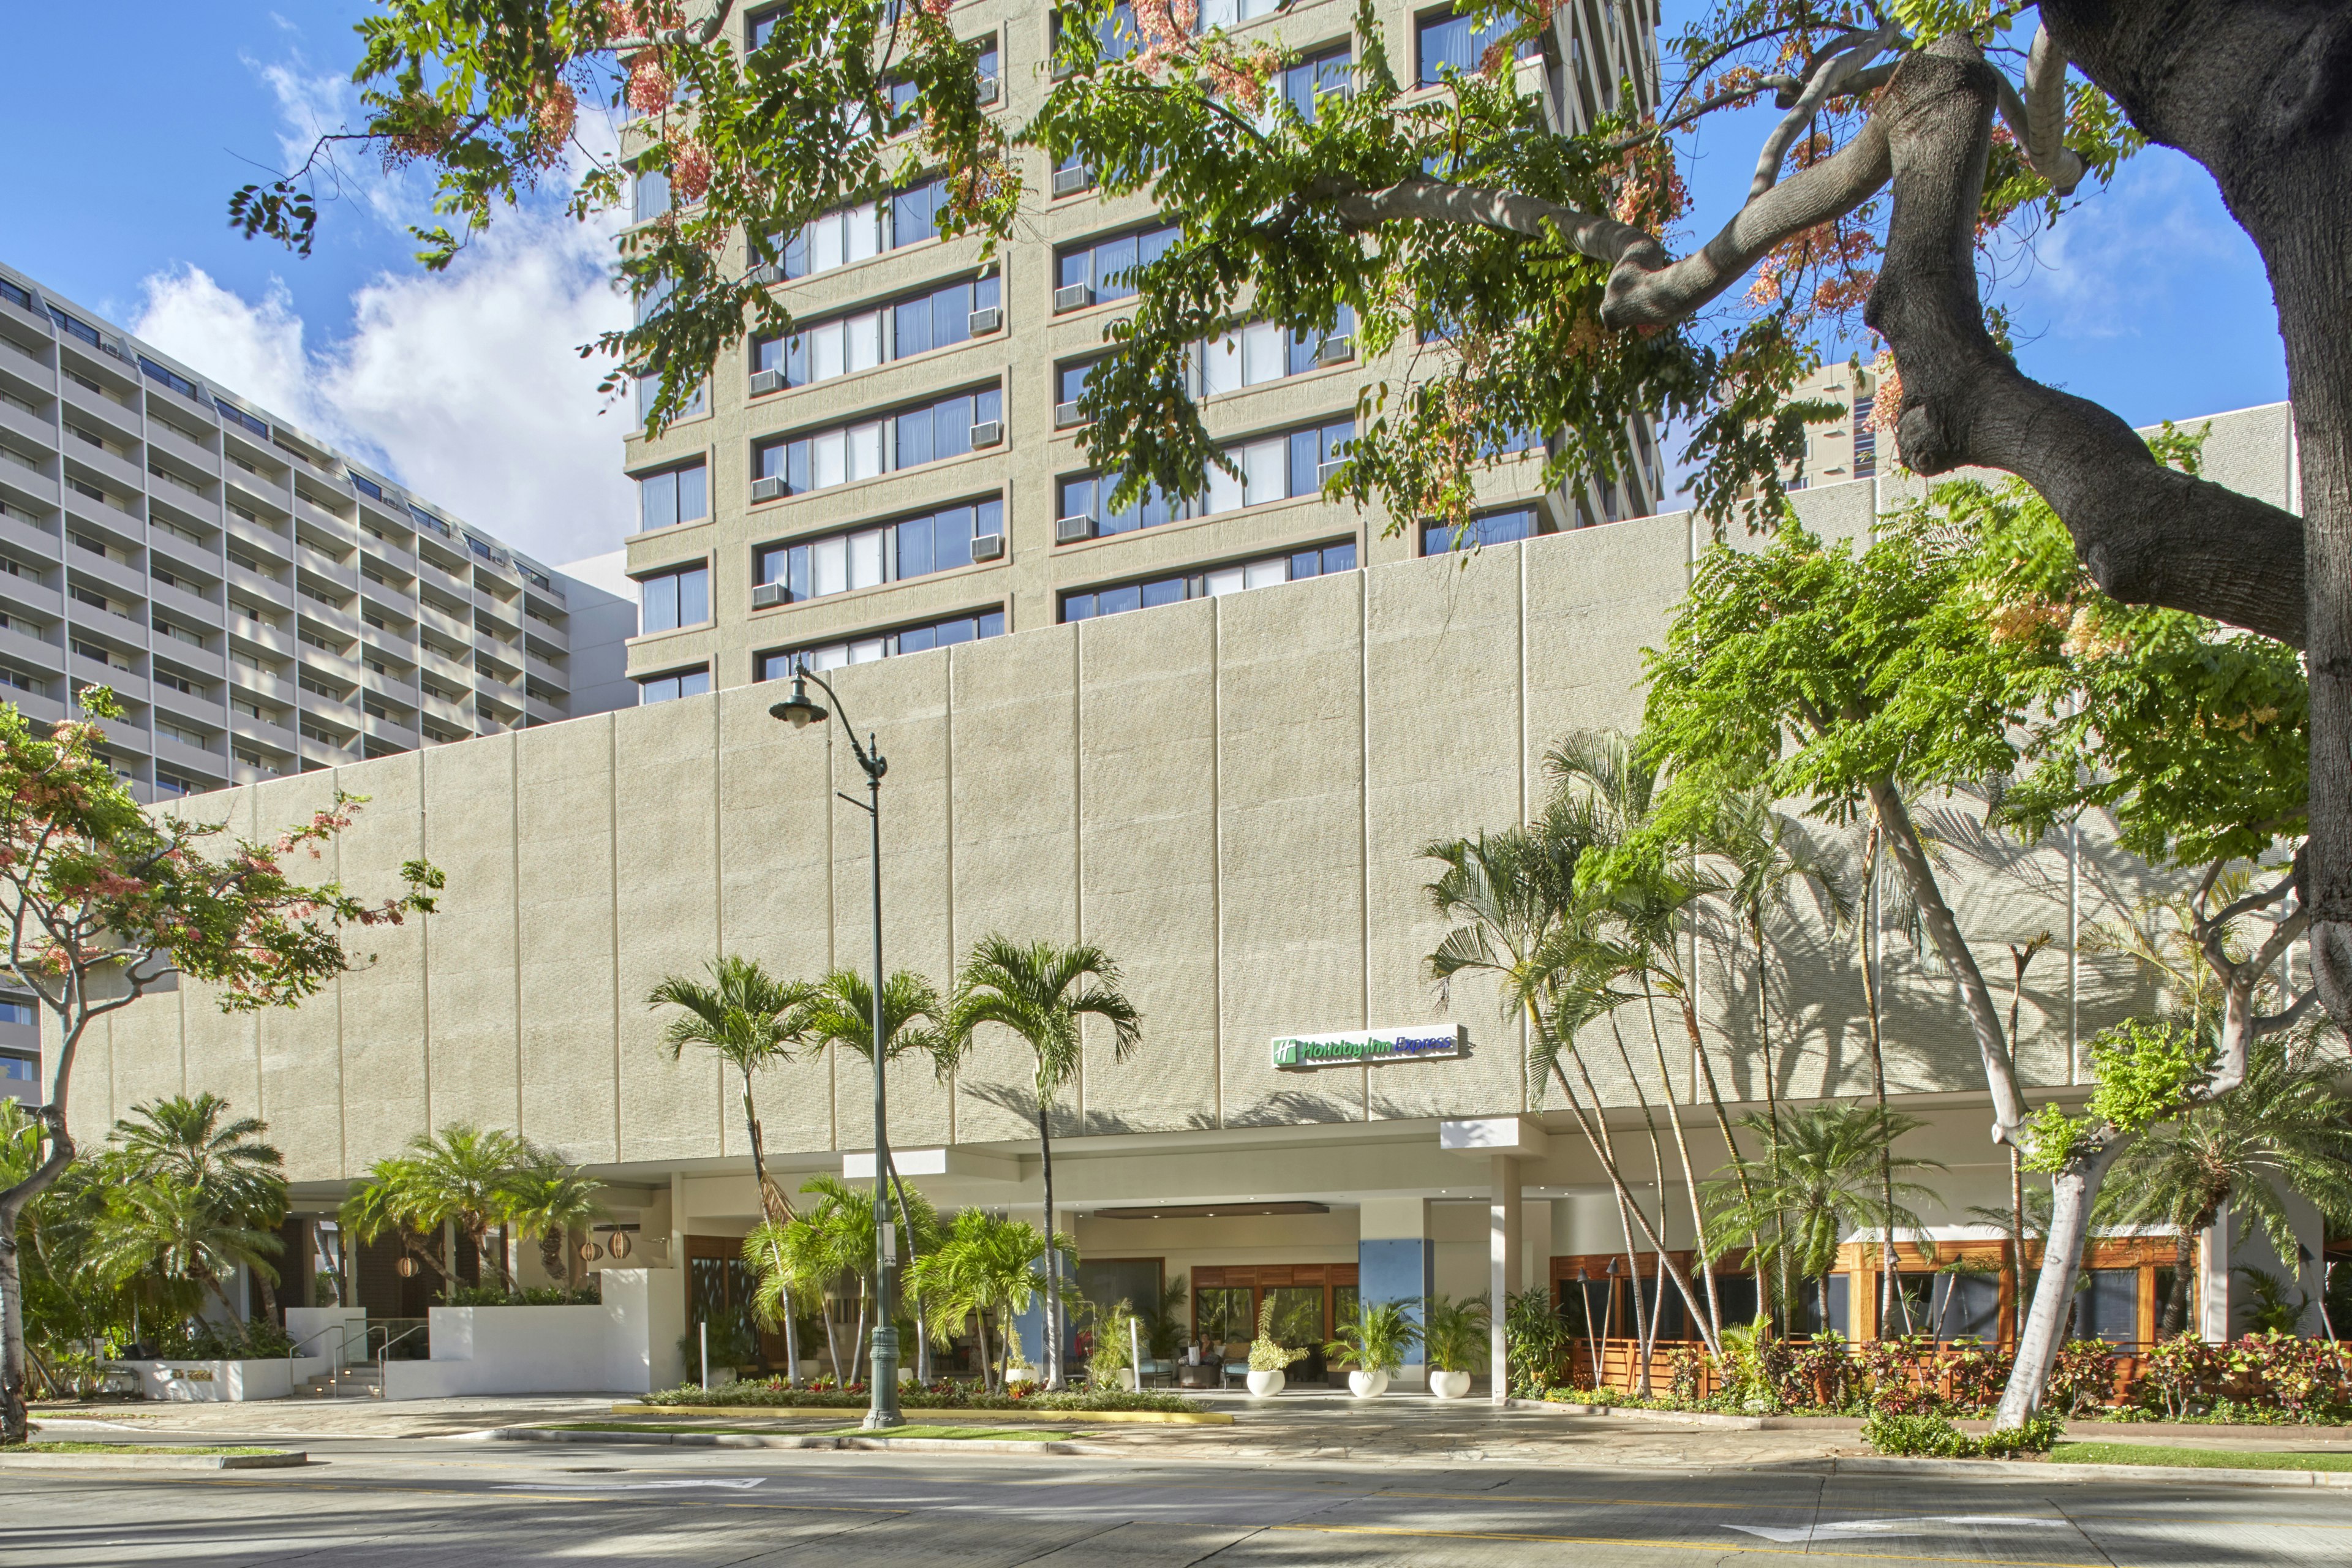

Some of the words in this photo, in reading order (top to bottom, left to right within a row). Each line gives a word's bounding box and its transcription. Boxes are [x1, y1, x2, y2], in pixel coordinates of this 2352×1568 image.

[1302, 1039, 1364, 1059] Holiday
[1366, 1037, 1392, 1054] Inn
[1395, 1036, 1452, 1054] Express
